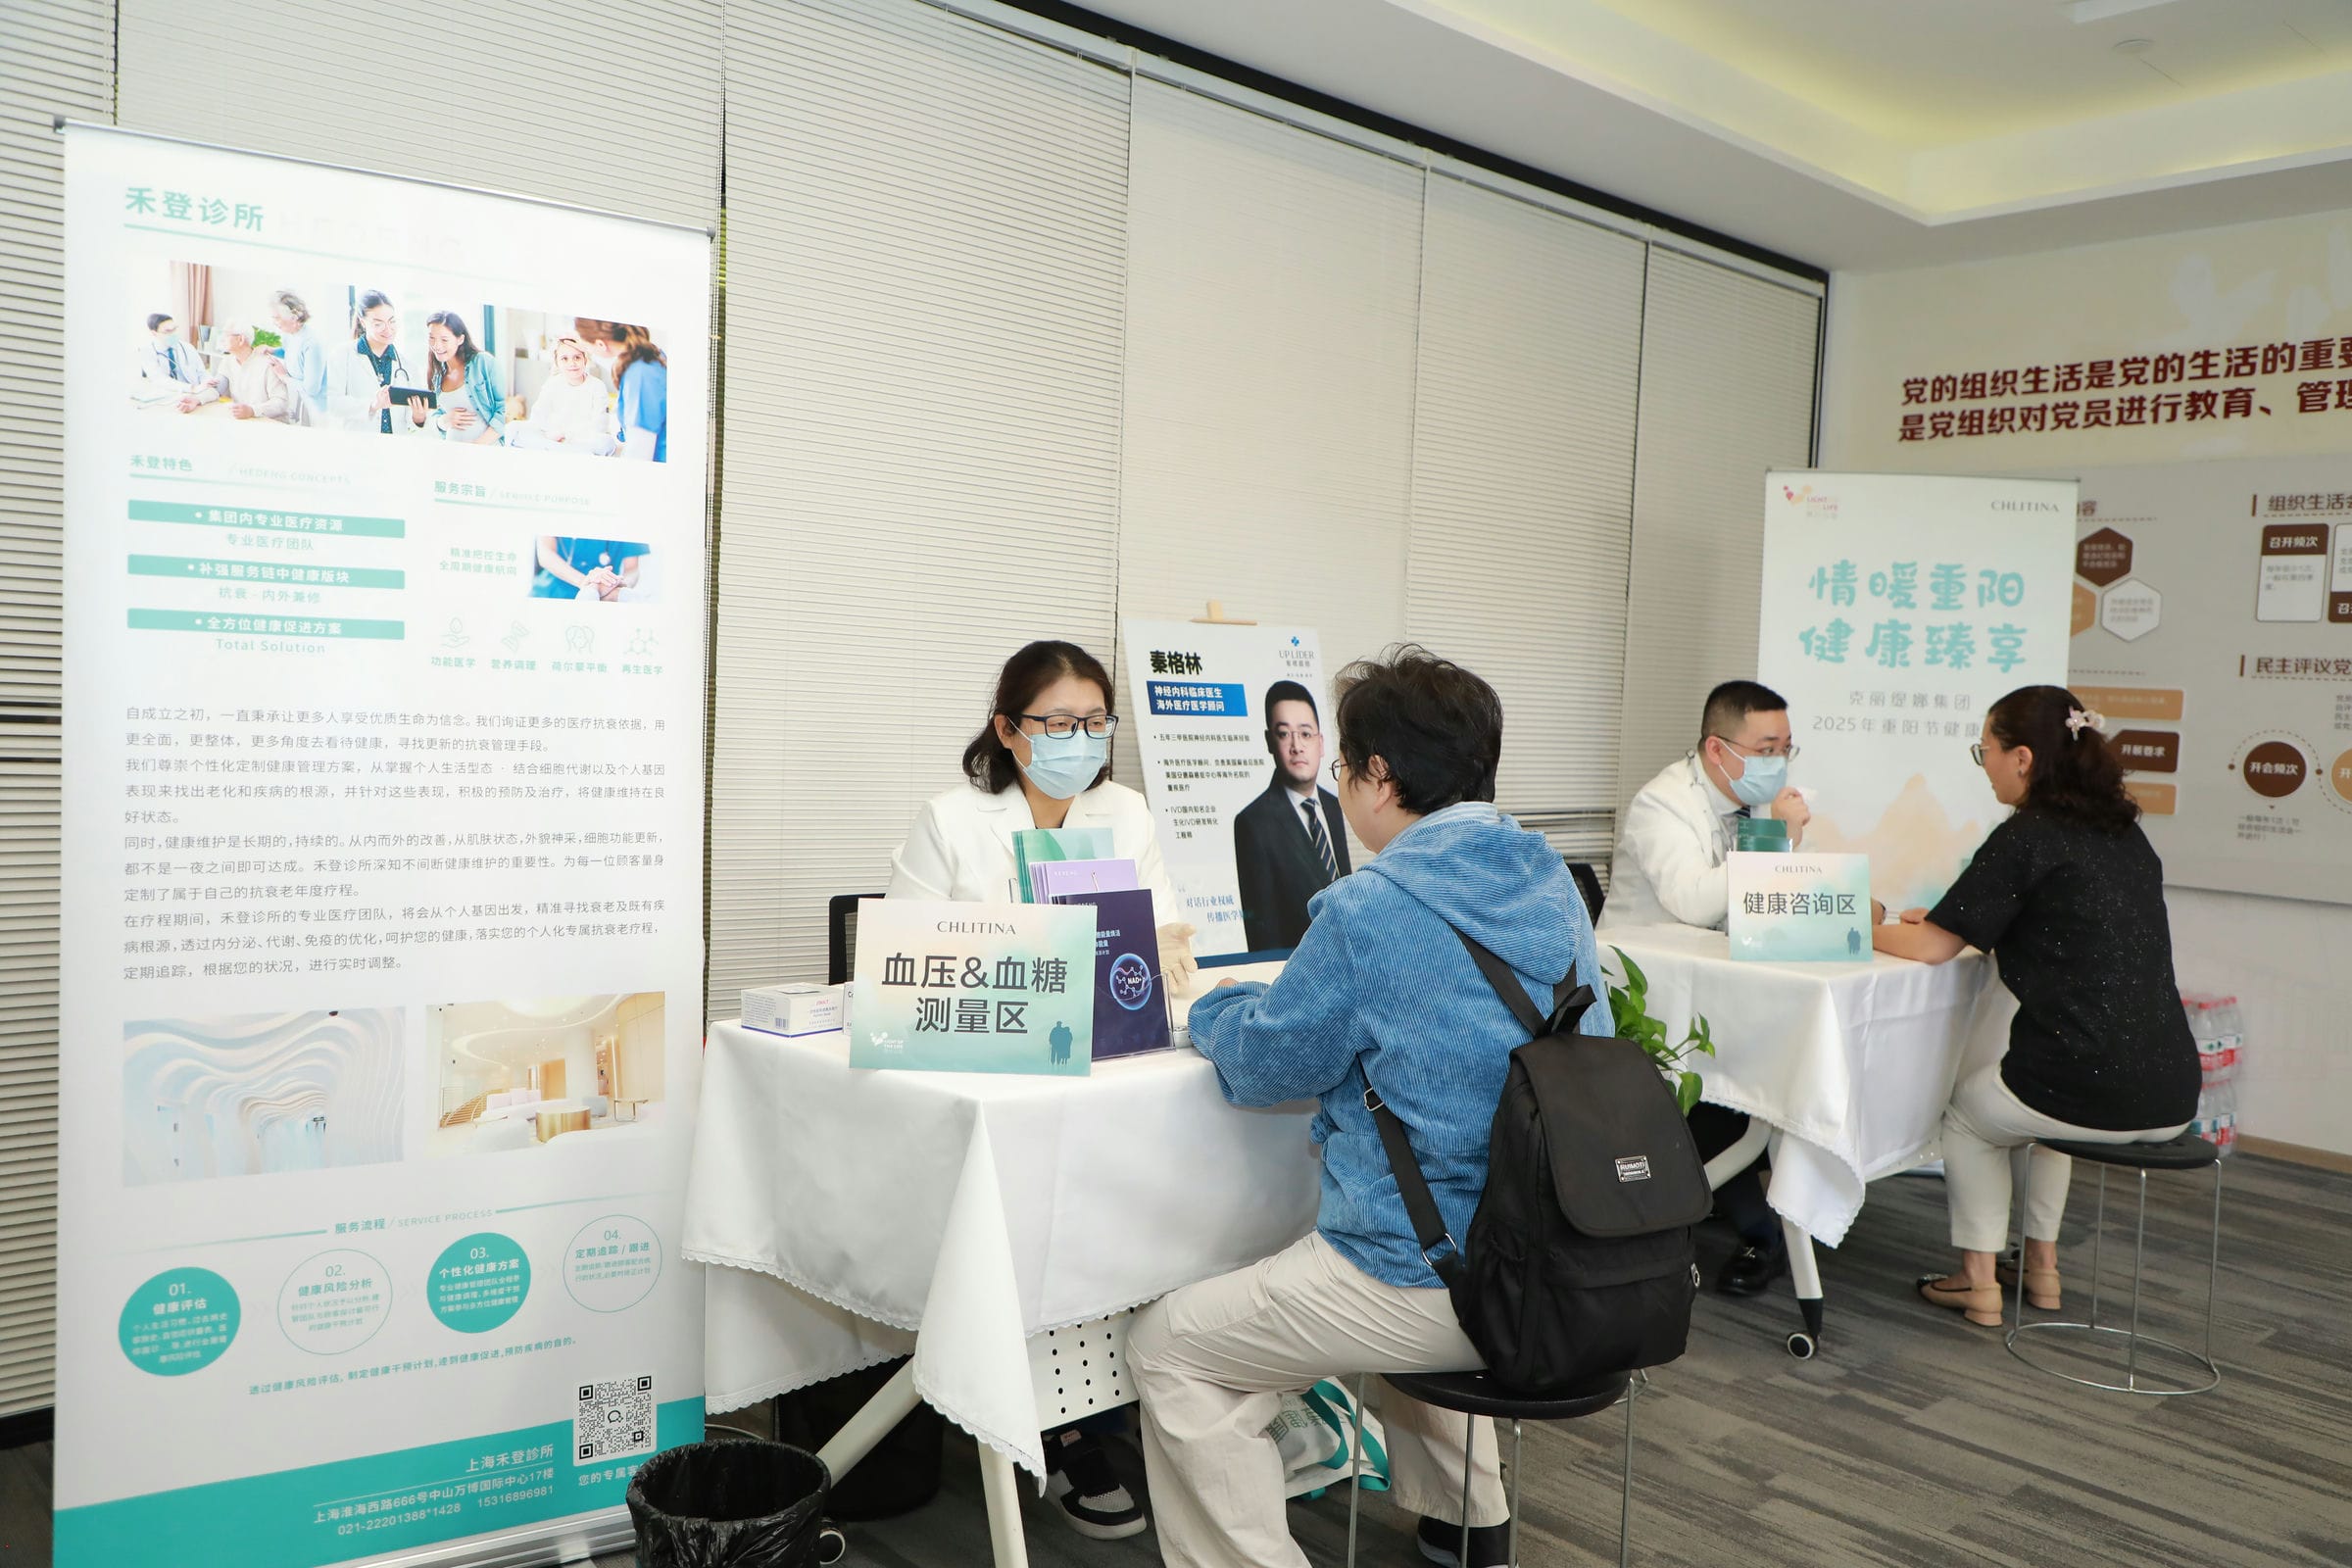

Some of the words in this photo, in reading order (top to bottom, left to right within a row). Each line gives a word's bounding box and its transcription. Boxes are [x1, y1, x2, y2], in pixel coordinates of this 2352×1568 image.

[125, 186, 264, 232] 禾登诊所
[129, 454, 193, 472] 禾登特色
[434, 480, 487, 498] 服务宗旨
[1990, 500, 2060, 513] CHLITINA
[208, 509, 344, 531] 集团内专业医疗资源
[226, 533, 315, 551] 专业医疗团队
[2269, 536, 2318, 549] 召开频次
[1809, 559, 2026, 611] 情暖重阳
[2337, 603, 2352, 615] 召
[207, 615, 342, 636] 全方位健康促进方案
[216, 638, 255, 652] Total
[261, 640, 325, 655] Solution
[1798, 617, 2028, 673] 健康臻享
[1150, 650, 1203, 675] 秦格林
[2256, 657, 2352, 676] 民主评议党
[1154, 684, 1223, 699] 神经内科临床医生
[1849, 690, 1971, 710] 克丽缇娜集团
[1156, 699, 1225, 712] 海外医疗医学顾问
[2249, 761, 2299, 775] 开会频次
[124, 809, 180, 825] 好状态。
[1775, 865, 1823, 874] CHLITINA
[1743, 892, 1856, 915] 健康咨询区
[937, 920, 1017, 936] CHLITINA
[882, 952, 1068, 995] 血压&血糖
[915, 997, 1029, 1035] 测量区
[334, 1218, 385, 1234] 服务流程
[397, 1214, 442, 1227] SERVICE
[439, 1257, 519, 1279] 个性化健康方案
[153, 1298, 208, 1316] 健康评估
[578, 1463, 645, 1487] 您的专属客
[477, 1485, 554, 1508] 15316896981
